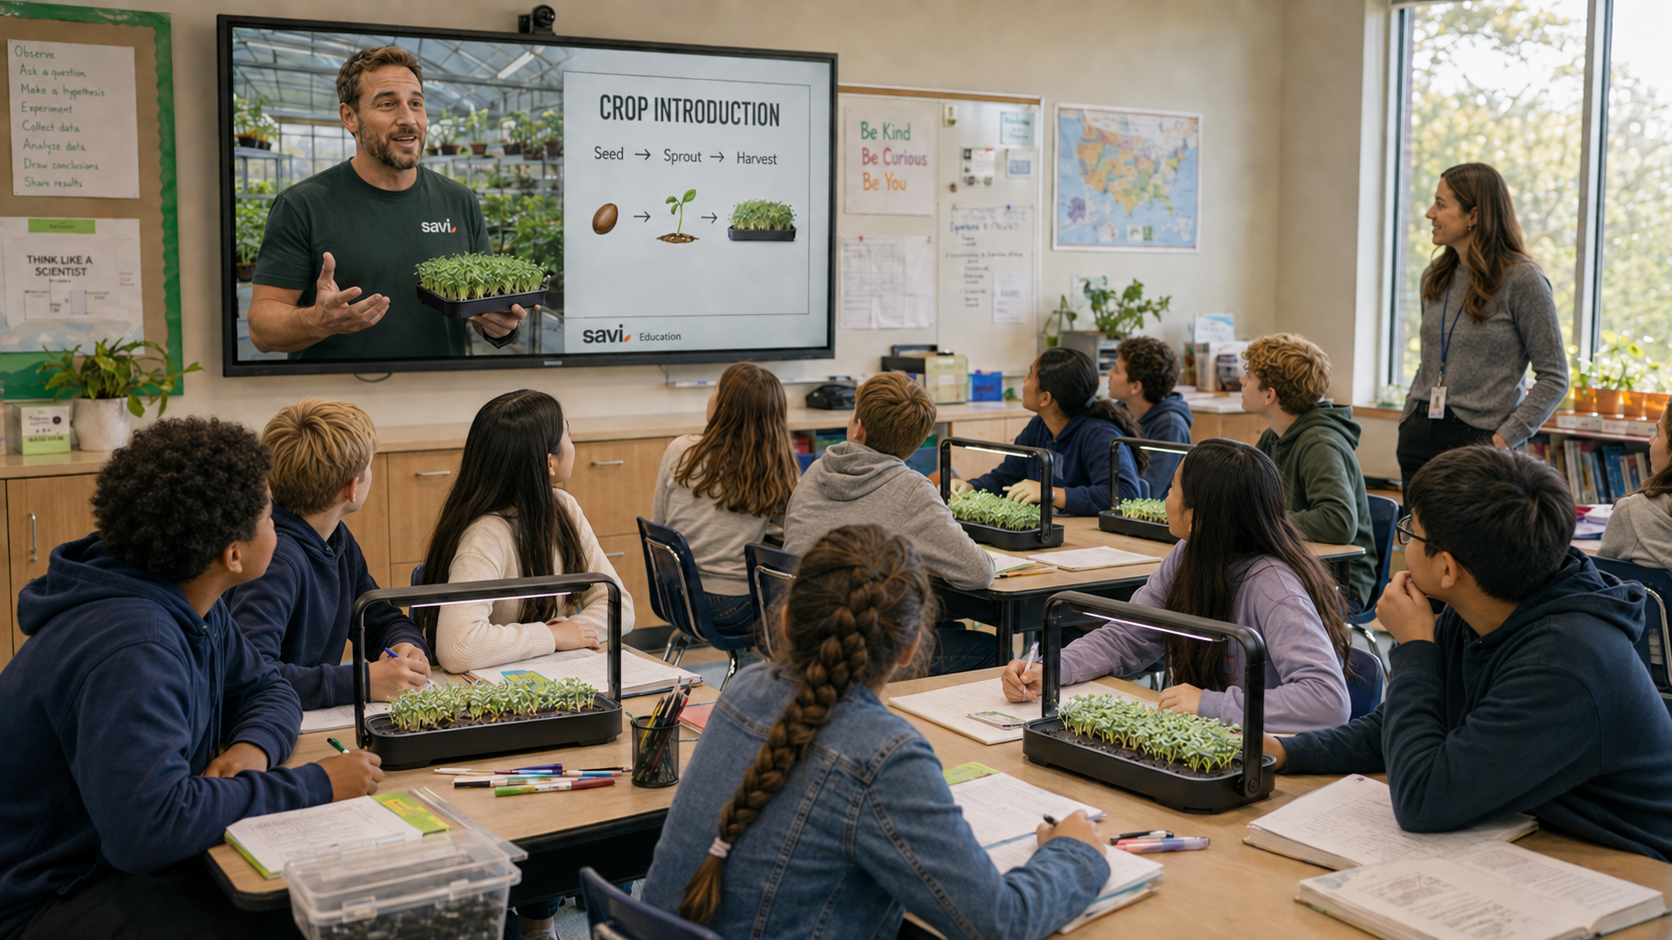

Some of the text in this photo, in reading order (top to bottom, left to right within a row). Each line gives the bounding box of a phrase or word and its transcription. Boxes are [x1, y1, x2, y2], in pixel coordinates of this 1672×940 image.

[15, 45, 55, 59] Observe
[20, 64, 86, 80] Ask a question
[21, 83, 47, 95] Make
[63, 85, 105, 99] hypothesis
[21, 101, 73, 116] Experiment
[600, 94, 780, 127] CROP INTRODUCTION
[22, 120, 80, 133] Collect data
[861, 121, 911, 141] Be Kind
[23, 138, 86, 154] Analyze data
[594, 146, 777, 165] Seed Sprout Harvest
[862, 147, 927, 166] Be Curious
[24, 157, 99, 171] Draw conclusions
[25, 176, 83, 188] Share results
[863, 172, 907, 191] Be You
[421, 218, 451, 233] savi
[27, 255, 93, 265] THINK LIKE A
[35, 267, 87, 276] SCIENTIST
[582, 324, 682, 344] savi Education
